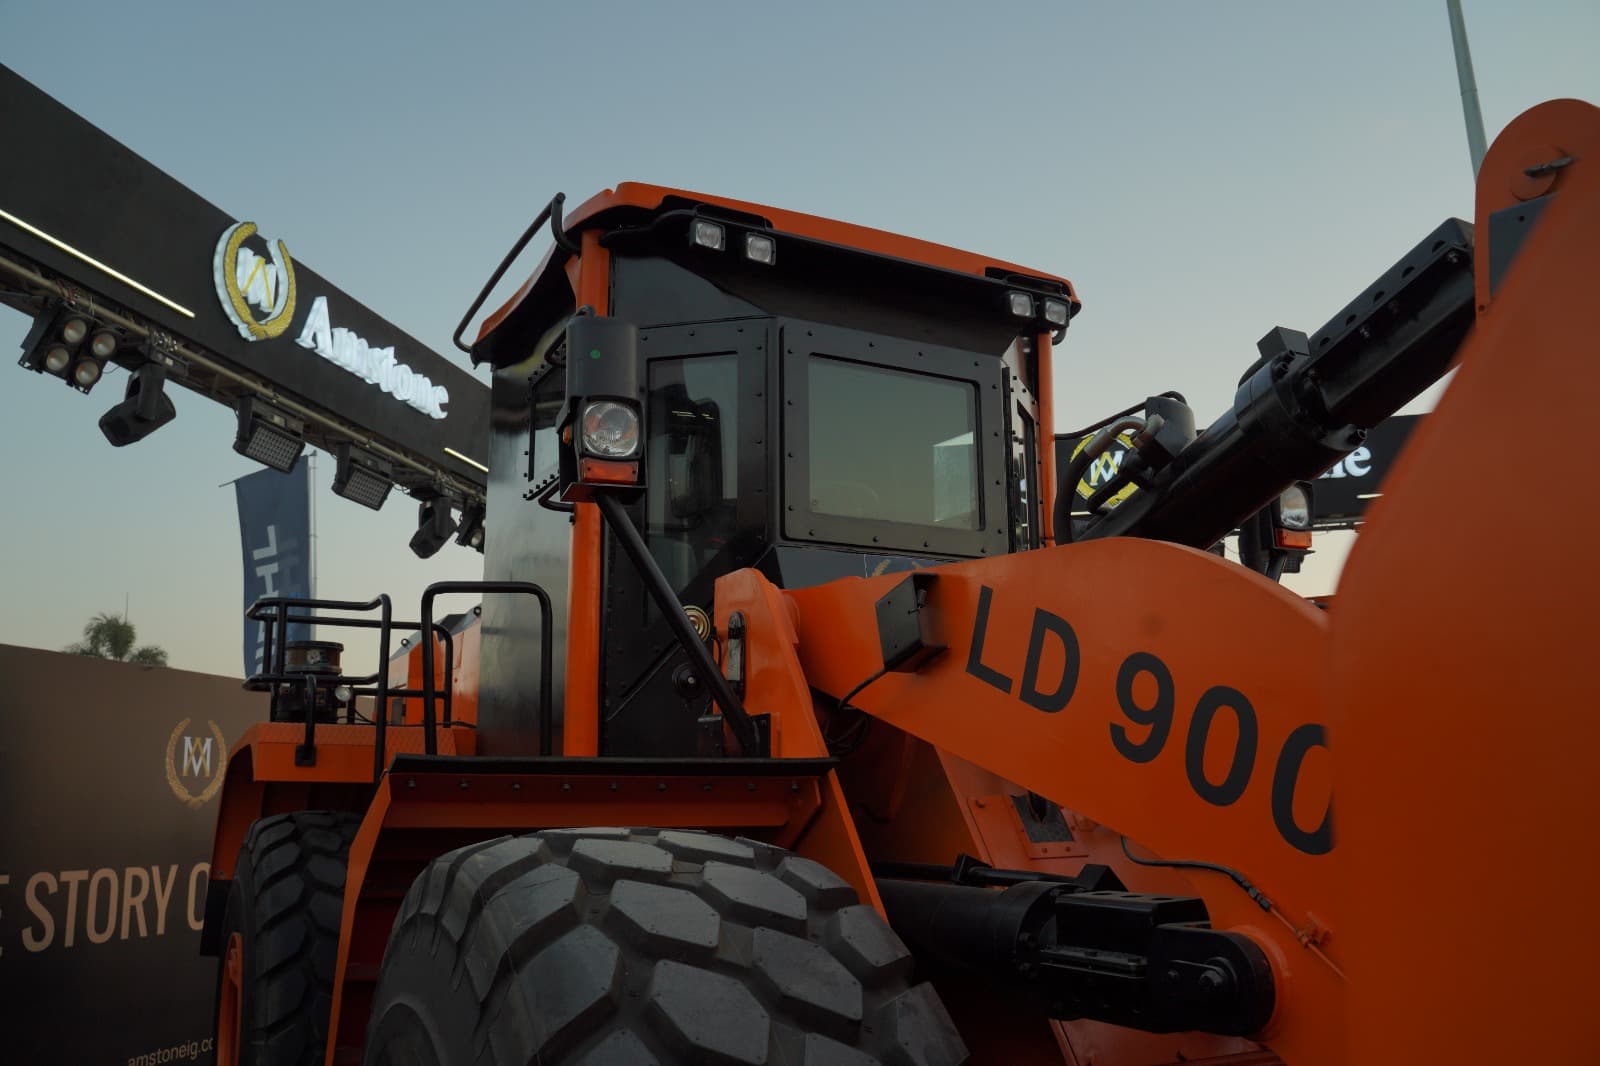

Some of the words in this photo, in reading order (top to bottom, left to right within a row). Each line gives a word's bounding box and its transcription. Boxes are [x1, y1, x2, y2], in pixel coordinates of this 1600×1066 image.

[965, 584, 1081, 714] LD
[1109, 651, 1335, 856] 900
[21, 863, 179, 953] STORY
